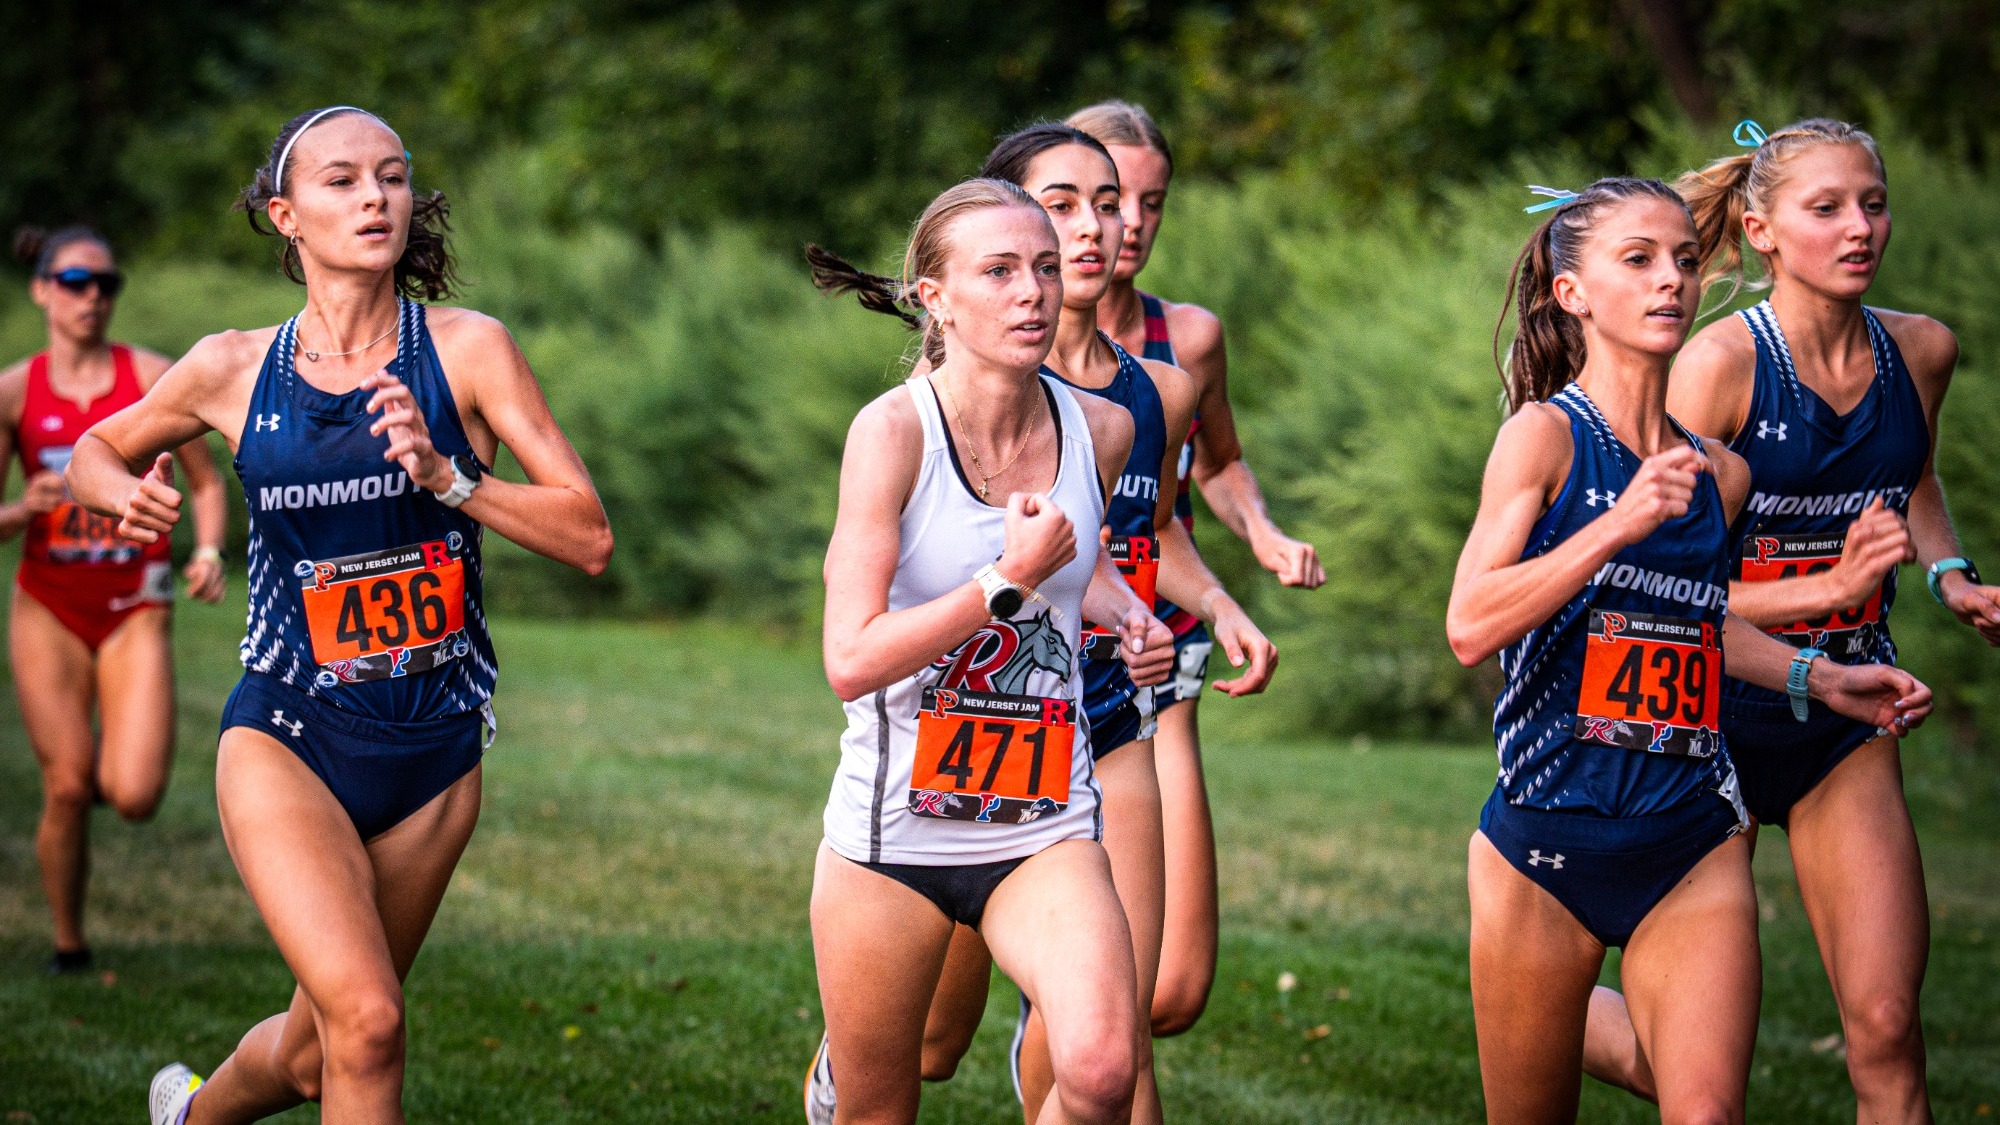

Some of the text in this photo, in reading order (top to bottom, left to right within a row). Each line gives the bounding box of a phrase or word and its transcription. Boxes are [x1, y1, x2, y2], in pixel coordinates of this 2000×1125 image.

[421, 541, 455, 570] R
[1110, 543, 1127, 552] JAM
[1128, 536, 1153, 564] R
[1754, 537, 1780, 565] P
[1784, 542, 1806, 552] NEW
[1806, 540, 1839, 551] JERSEY
[314, 562, 337, 593] P
[341, 551, 421, 574] NEW JERSEY JAM
[336, 571, 447, 652] 436
[1600, 611, 1627, 643] P
[1631, 621, 1654, 632] NEW
[1654, 622, 1685, 635] JERSEY
[1700, 621, 1717, 652] R
[386, 647, 411, 678] P
[1606, 644, 1707, 725] 439
[931, 688, 959, 720] P
[963, 697, 1041, 713] NEW JERSEY JAM
[1039, 698, 1070, 729] R
[1648, 720, 1674, 753] P
[937, 719, 1048, 797] 471
[975, 792, 1002, 823] P
